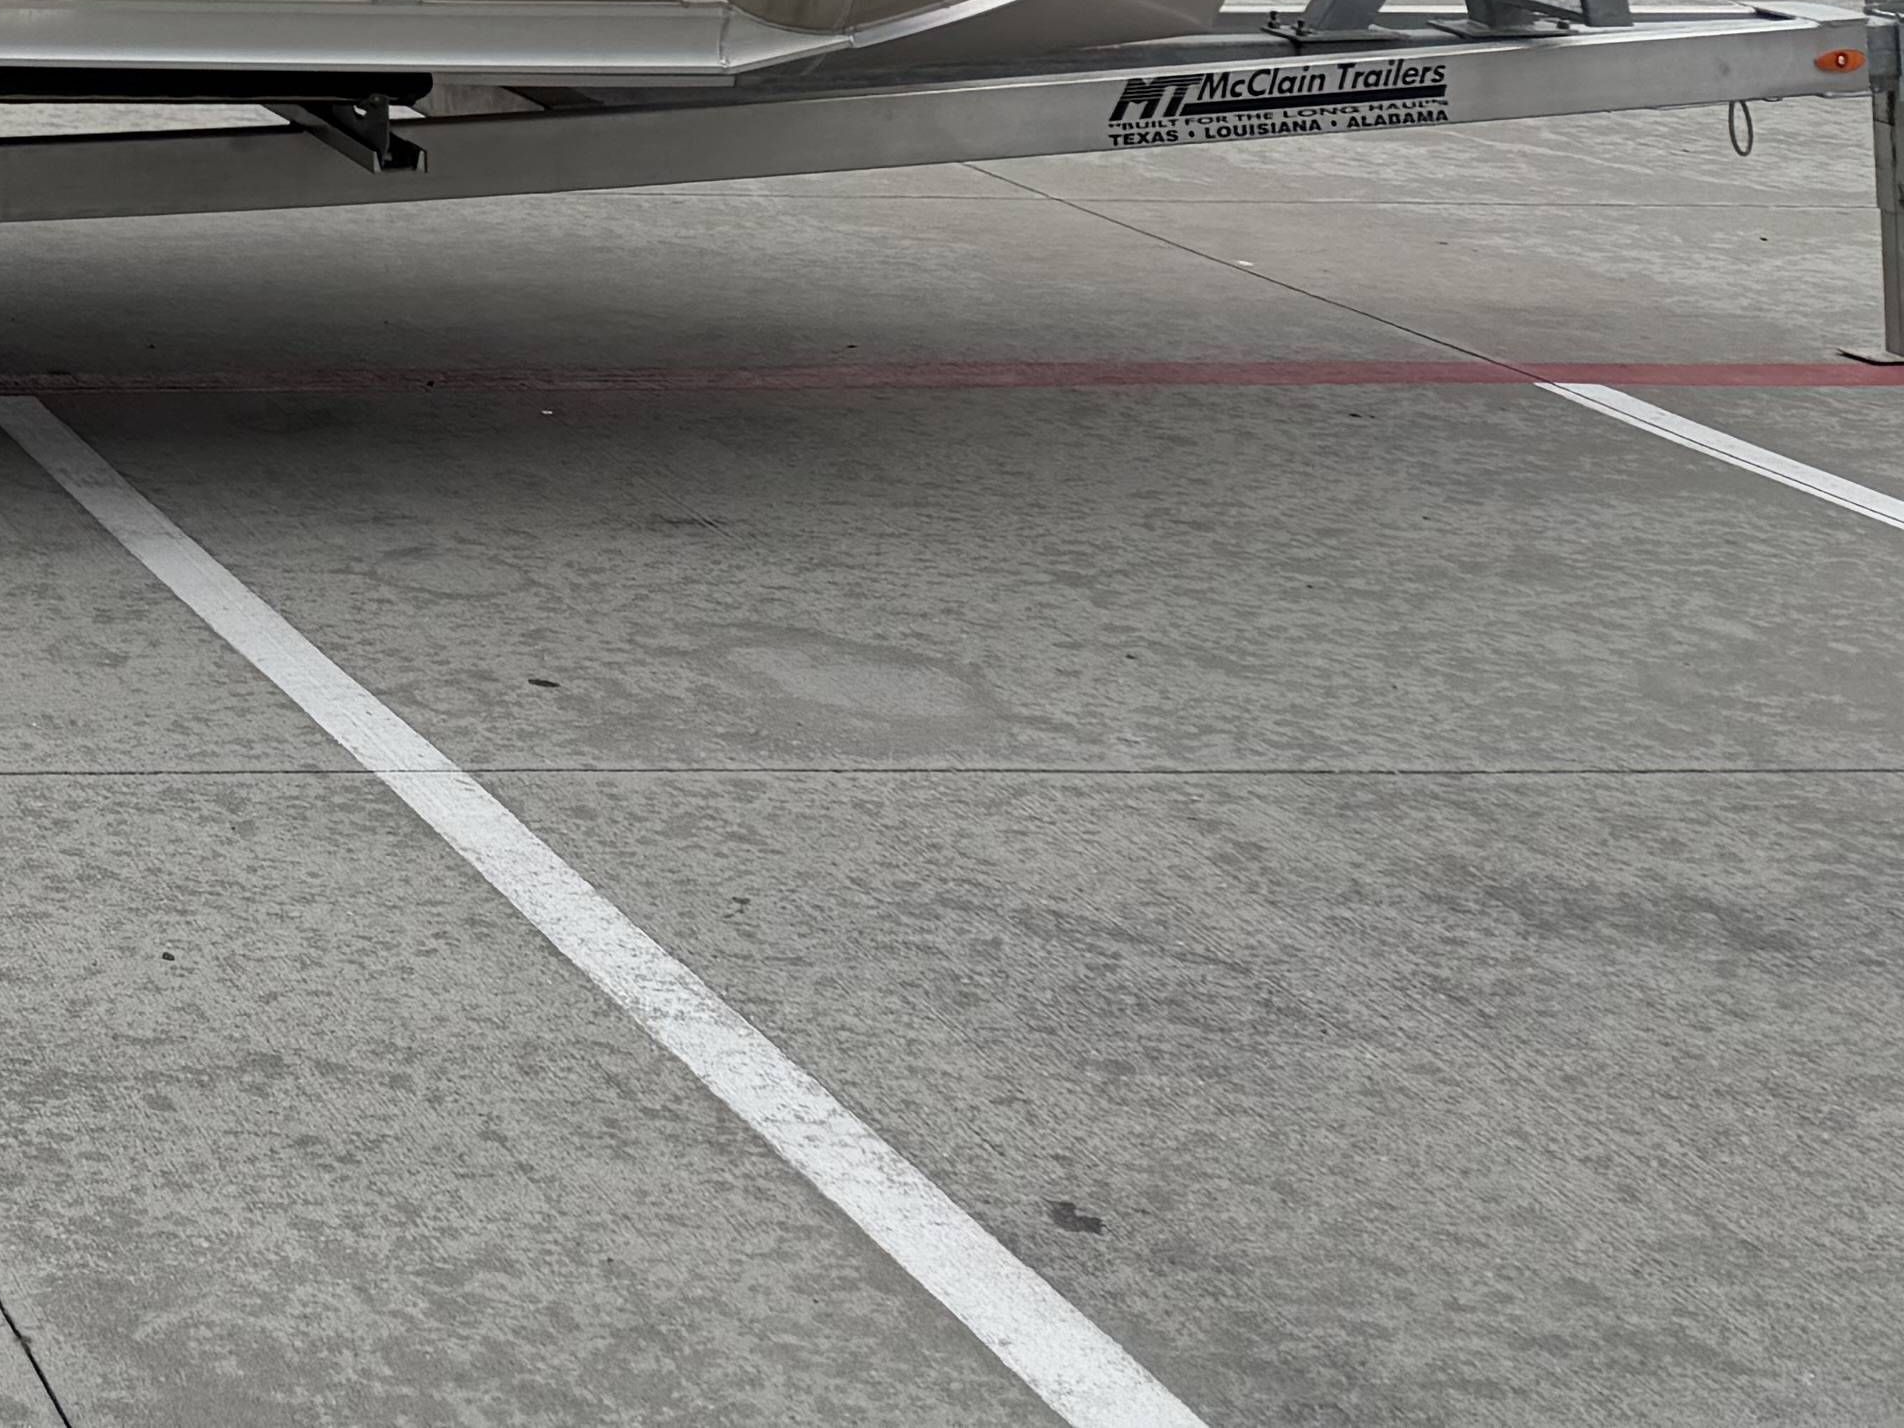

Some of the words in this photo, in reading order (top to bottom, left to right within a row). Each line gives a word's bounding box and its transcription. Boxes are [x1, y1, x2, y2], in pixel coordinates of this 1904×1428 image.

[1197, 65, 1327, 101] McClain
[1336, 58, 1447, 91] Trailers
[1108, 130, 1179, 146] TEXAS
[1204, 120, 1323, 140] LOUISIANA
[1346, 109, 1449, 129] ALABAMA
[1184, 113, 1228, 126] FOR
[1235, 110, 1275, 123] THE
[1283, 105, 1361, 119] LONG
